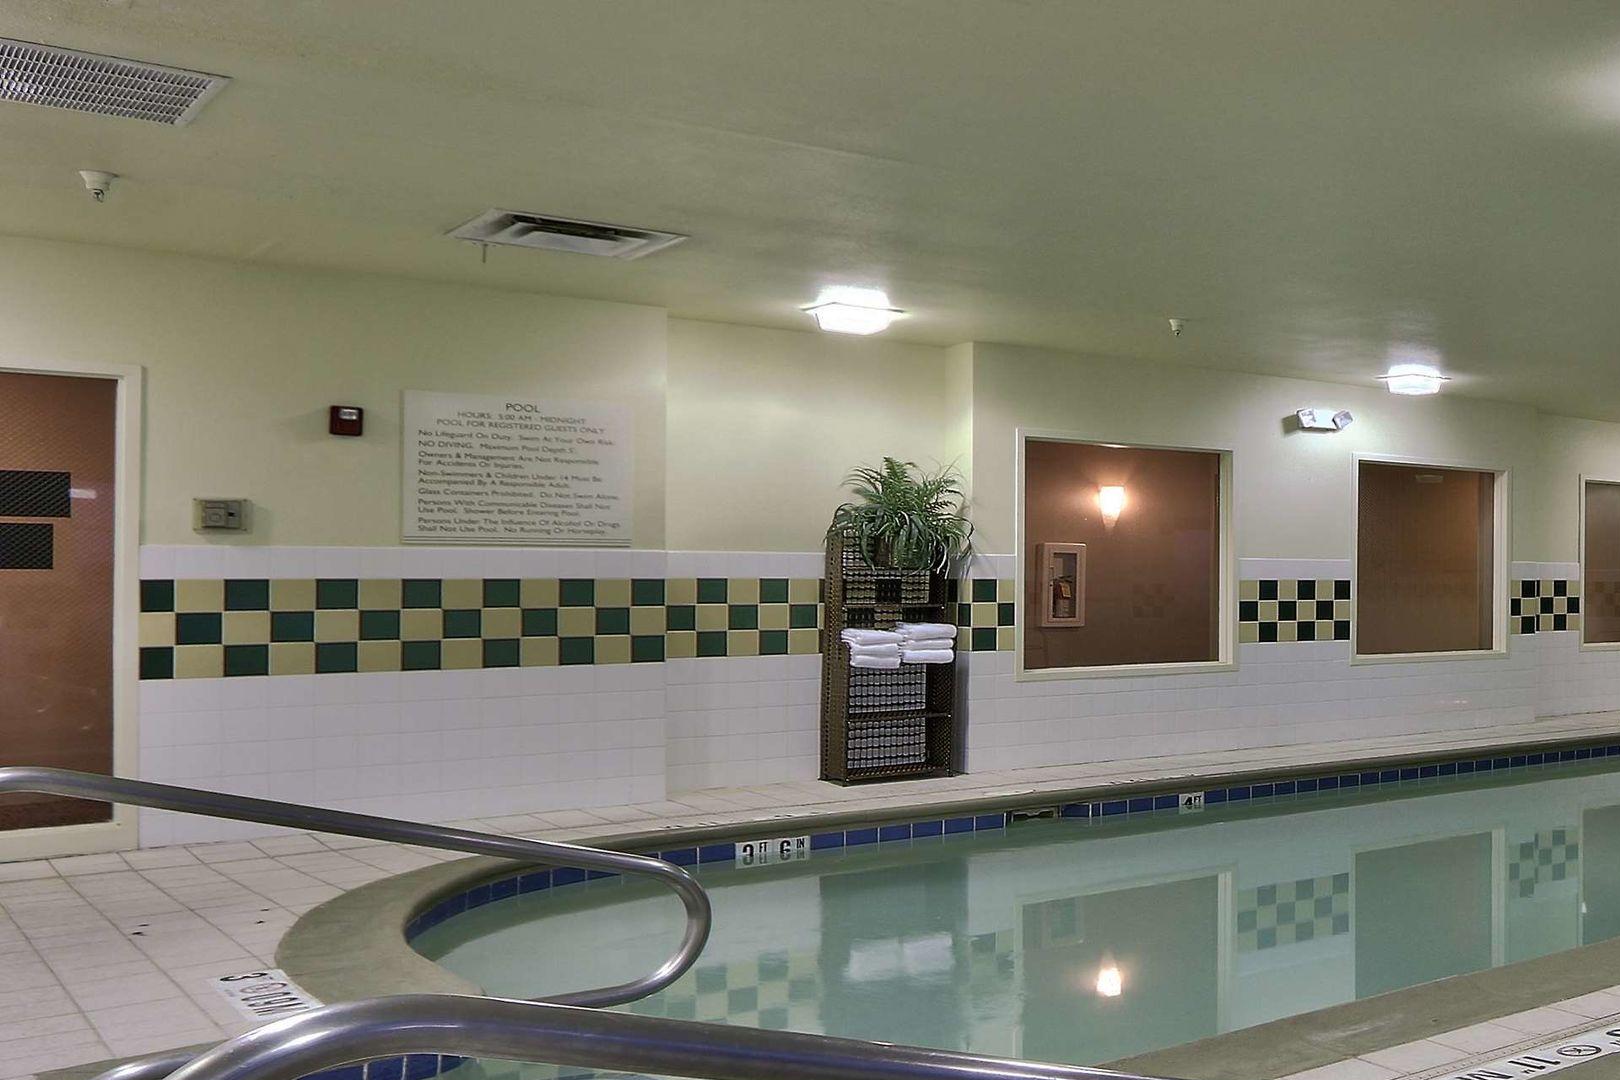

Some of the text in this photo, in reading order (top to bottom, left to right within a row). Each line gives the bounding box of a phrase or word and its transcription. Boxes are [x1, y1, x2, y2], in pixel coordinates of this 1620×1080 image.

[505, 403, 540, 413] POOL
[541, 416, 586, 424] MIDNIGHT
[436, 418, 604, 434] POOL FOR REGISTERED GUESTS ONLY
[435, 431, 472, 439] Lifeguard
[418, 440, 435, 448] NO
[480, 443, 519, 451] Maximum
[418, 450, 452, 459] Owners
[464, 452, 515, 462] Management
[553, 457, 599, 466] Responsible
[436, 460, 476, 468] Accidents
[495, 472, 530, 480] Children
[418, 477, 475, 486] Accompanied
[500, 480, 546, 488] Responsible
[418, 487, 440, 495] Glass
[443, 488, 489, 496] Containers
[418, 498, 451, 506] Persons
[478, 500, 538, 508] Communicable
[526, 509, 559, 517] Entering
[519, 527, 552, 535] Running
[796, 838, 805, 849] IN
